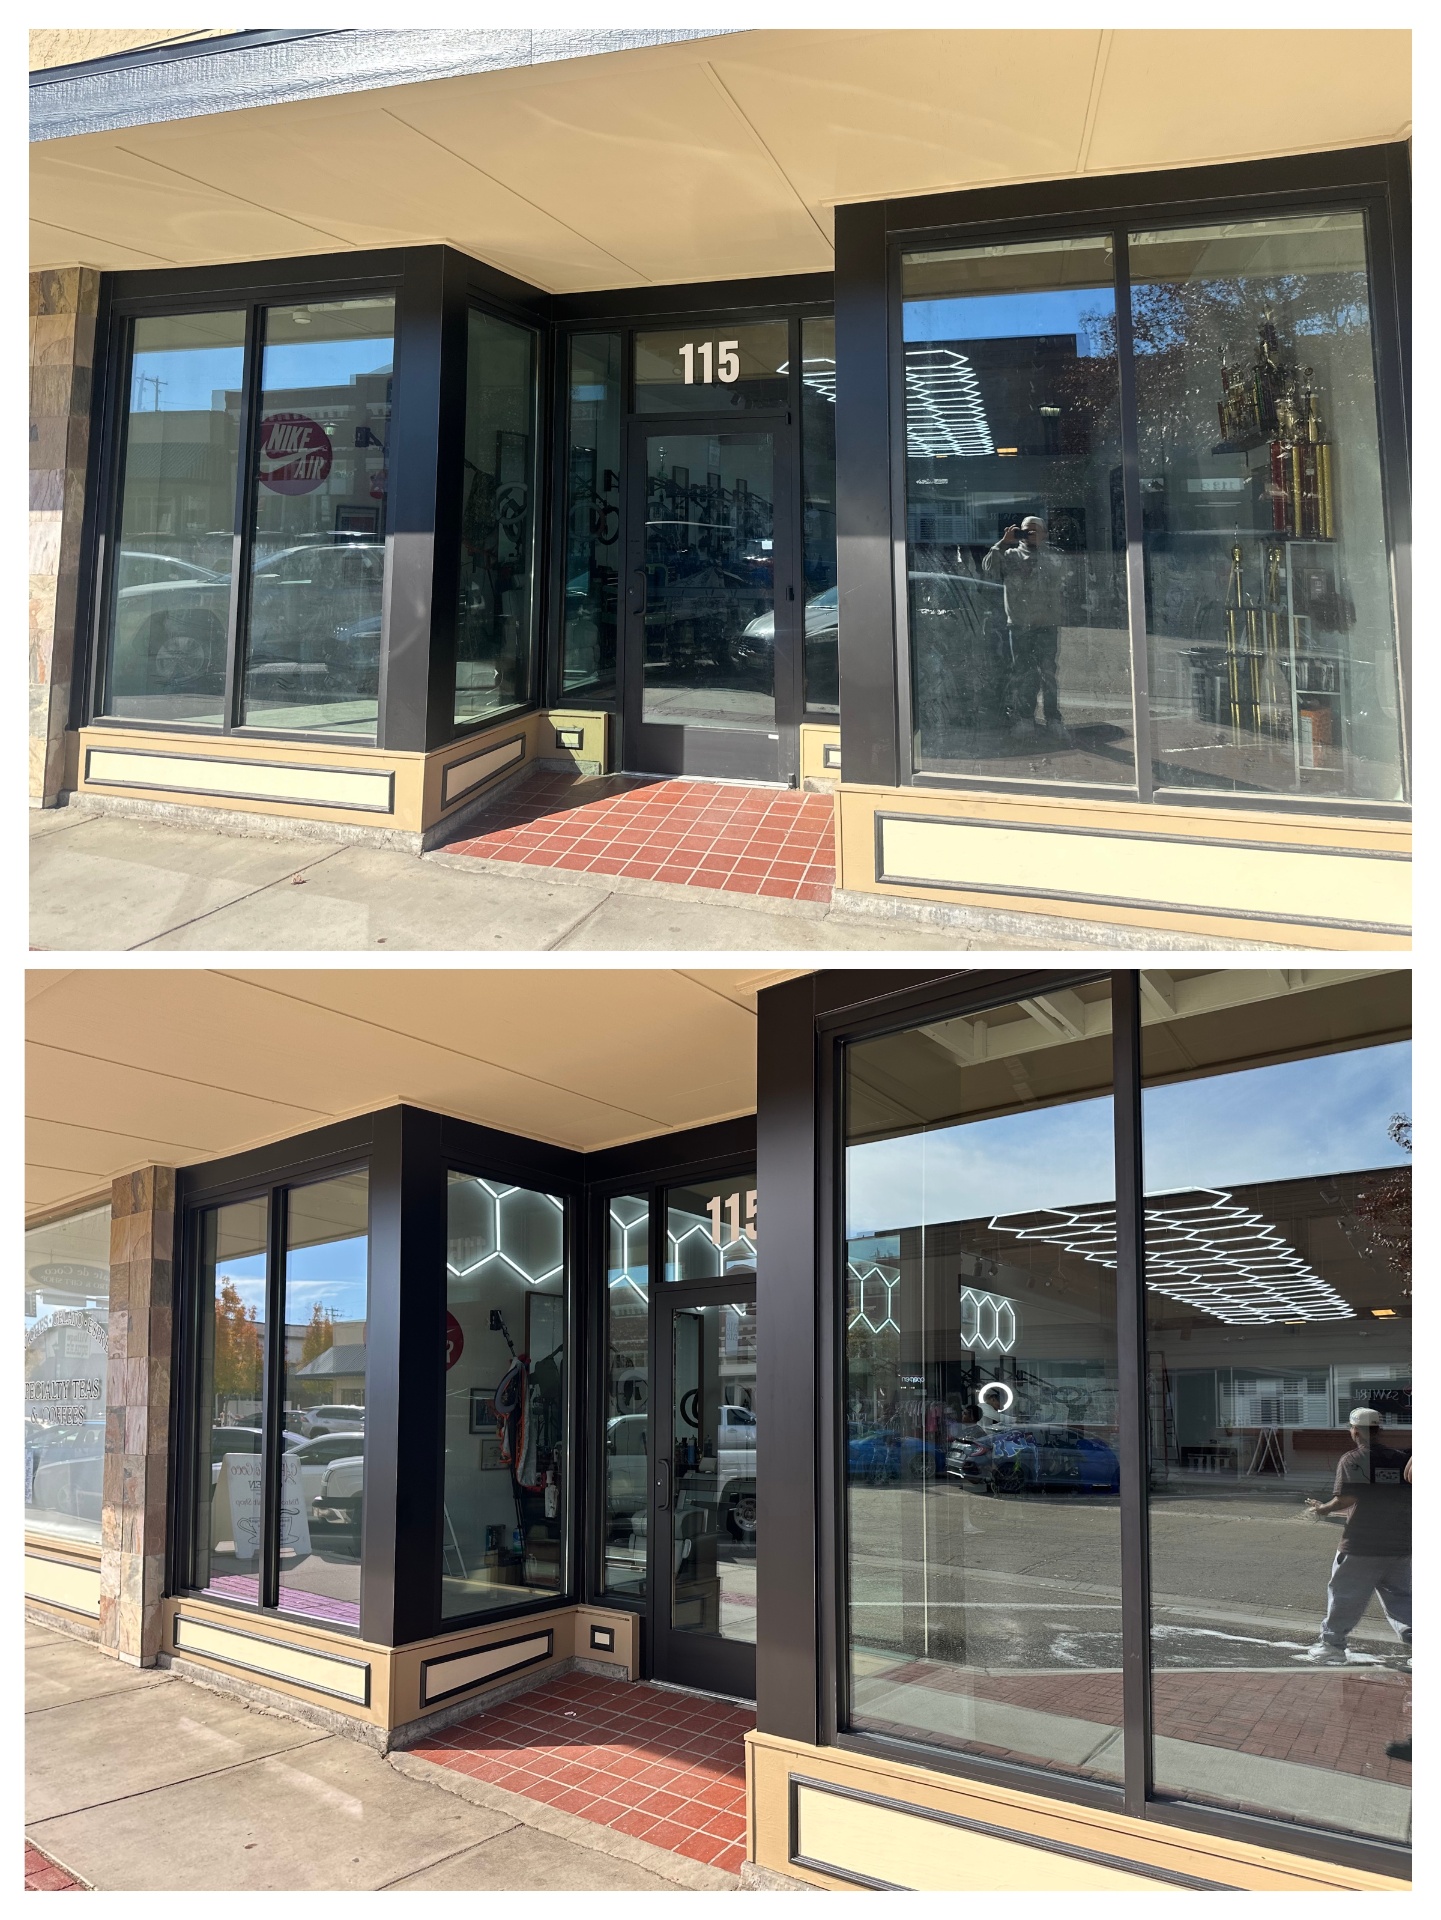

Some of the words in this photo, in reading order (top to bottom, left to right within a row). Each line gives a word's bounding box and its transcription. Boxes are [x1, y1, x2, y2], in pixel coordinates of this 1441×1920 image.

[678, 340, 740, 385] 115
[266, 423, 313, 453] NIKE
[294, 455, 325, 480] AIR
[706, 1189, 757, 1245] 115
[25, 1379, 70, 1400] PECIALTY
[71, 1378, 101, 1399] TEAS
